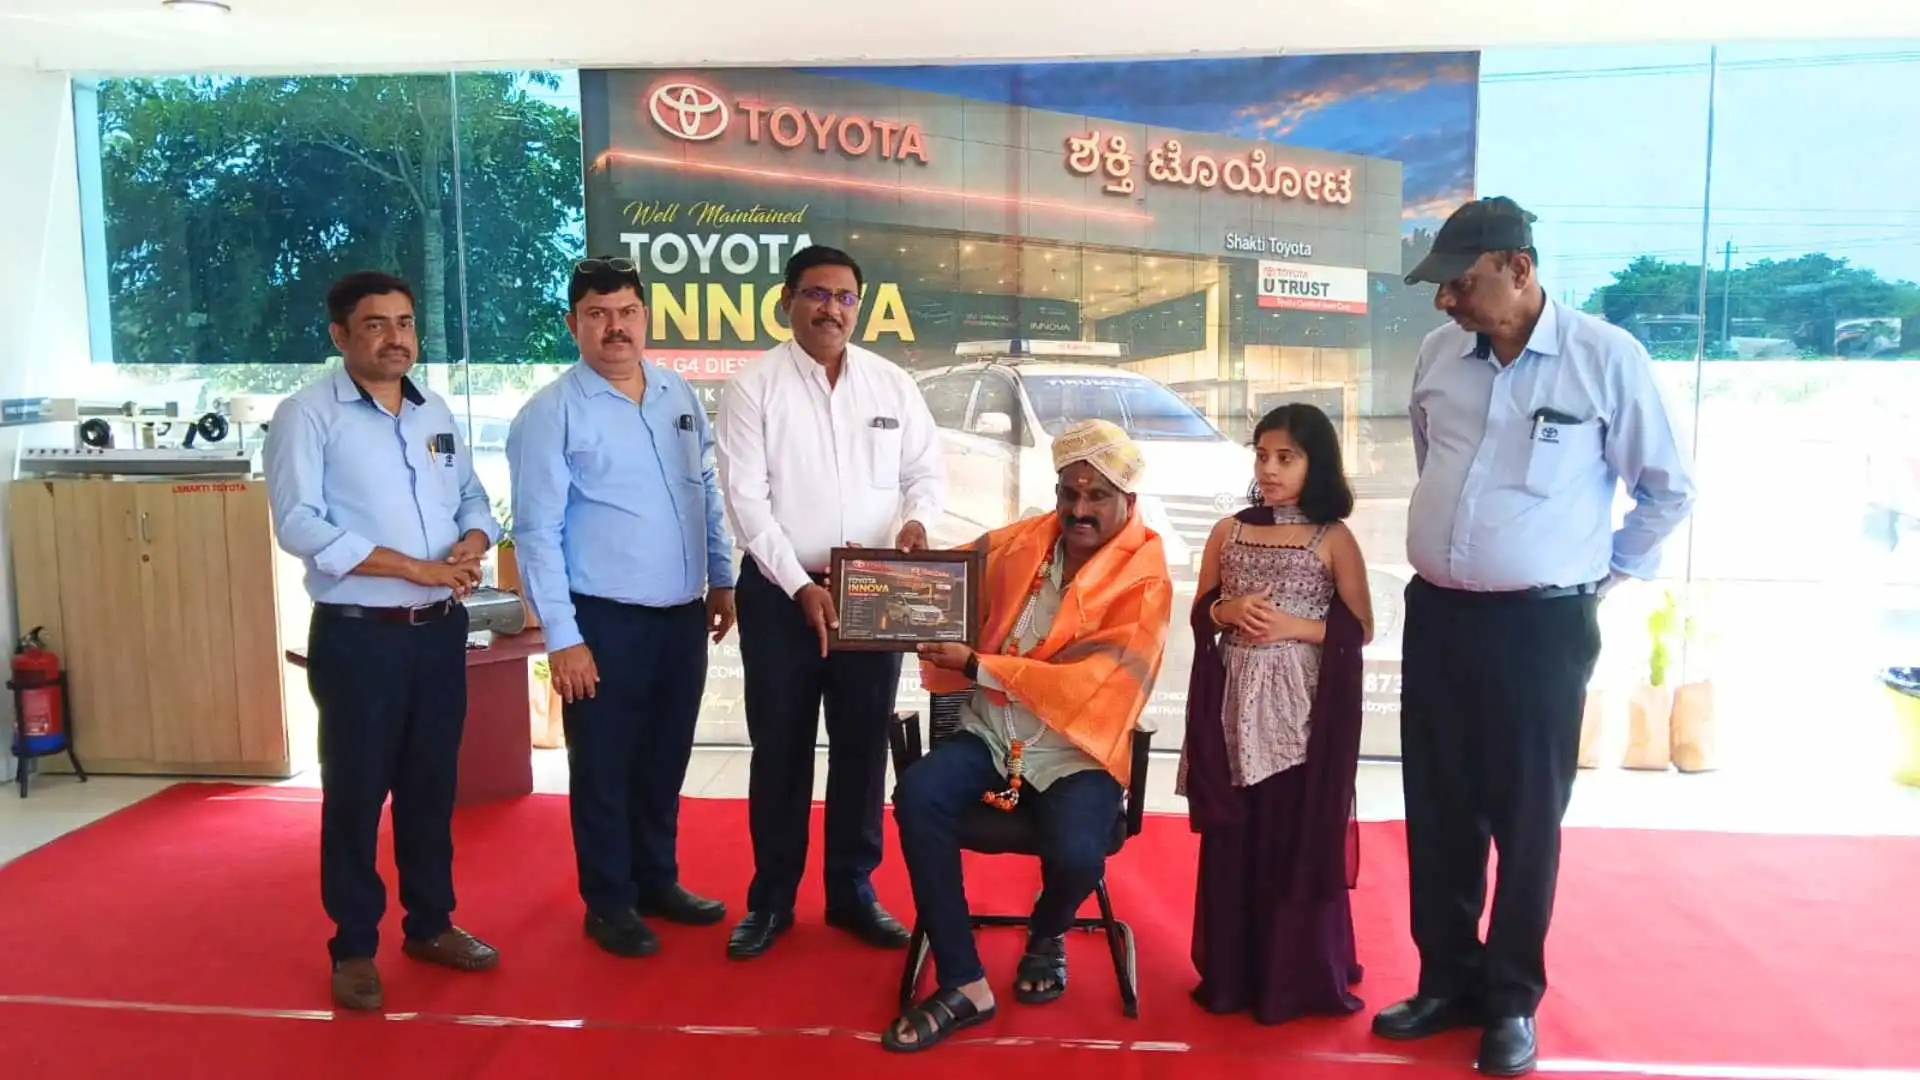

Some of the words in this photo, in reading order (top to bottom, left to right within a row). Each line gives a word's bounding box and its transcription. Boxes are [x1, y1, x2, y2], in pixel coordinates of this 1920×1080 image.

[737, 102, 929, 164] TOYOTA
[1068, 131, 1135, 194] ಶಕ್ತಿ
[623, 201, 679, 226] Well
[688, 203, 809, 228] Maintained
[1225, 233, 1266, 252] Shakti
[1269, 237, 1313, 257] Toyota
[1263, 278, 1275, 293] U
[1277, 279, 1330, 297] TRUST
[673, 357, 700, 374] G4
[847, 583, 890, 593] INNOVA
